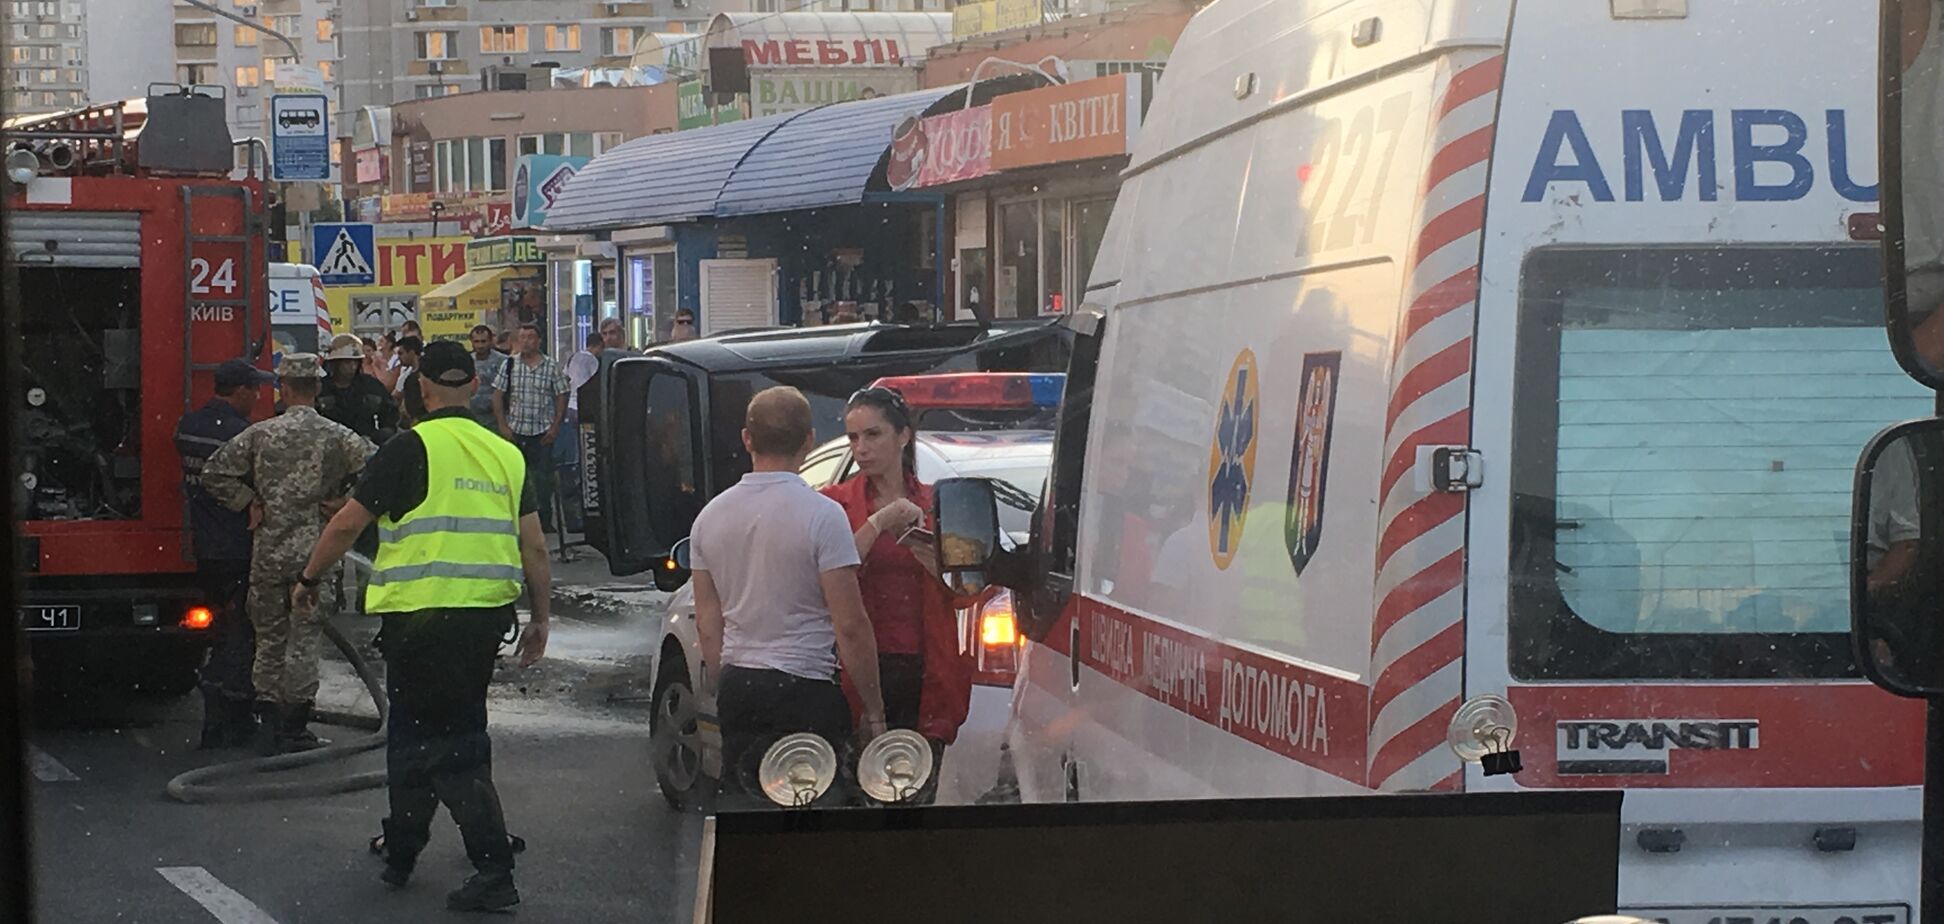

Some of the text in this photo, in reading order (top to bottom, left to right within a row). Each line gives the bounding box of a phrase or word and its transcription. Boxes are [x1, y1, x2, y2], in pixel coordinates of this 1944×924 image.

[741, 39, 900, 65] МЕБЛІ
[1049, 93, 1120, 144] КВІТИ
[1295, 91, 1412, 257] 227
[1521, 109, 1880, 202] AMBU
[191, 258, 236, 294] 24
[1091, 609, 1329, 756] ШВИДКА МЕДИЧНА ДОПОМОГА
[1558, 721, 1758, 750] TRANSIT
